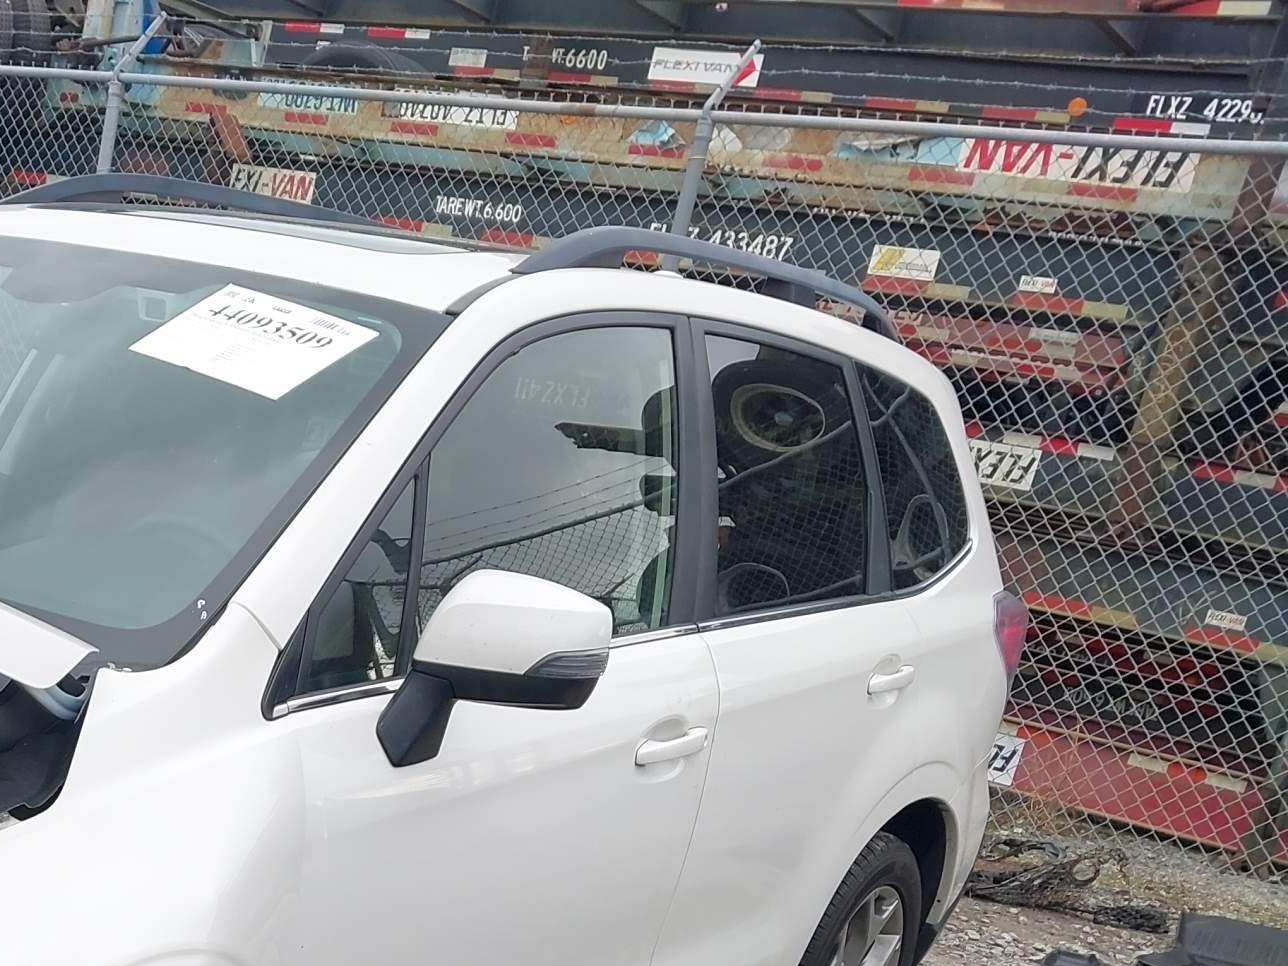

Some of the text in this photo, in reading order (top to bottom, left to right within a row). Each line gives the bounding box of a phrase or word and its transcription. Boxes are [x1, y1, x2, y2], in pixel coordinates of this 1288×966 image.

[565, 48, 608, 70] 6600
[1146, 95, 1193, 120] FLXZ
[208, 304, 334, 349] 44093509
